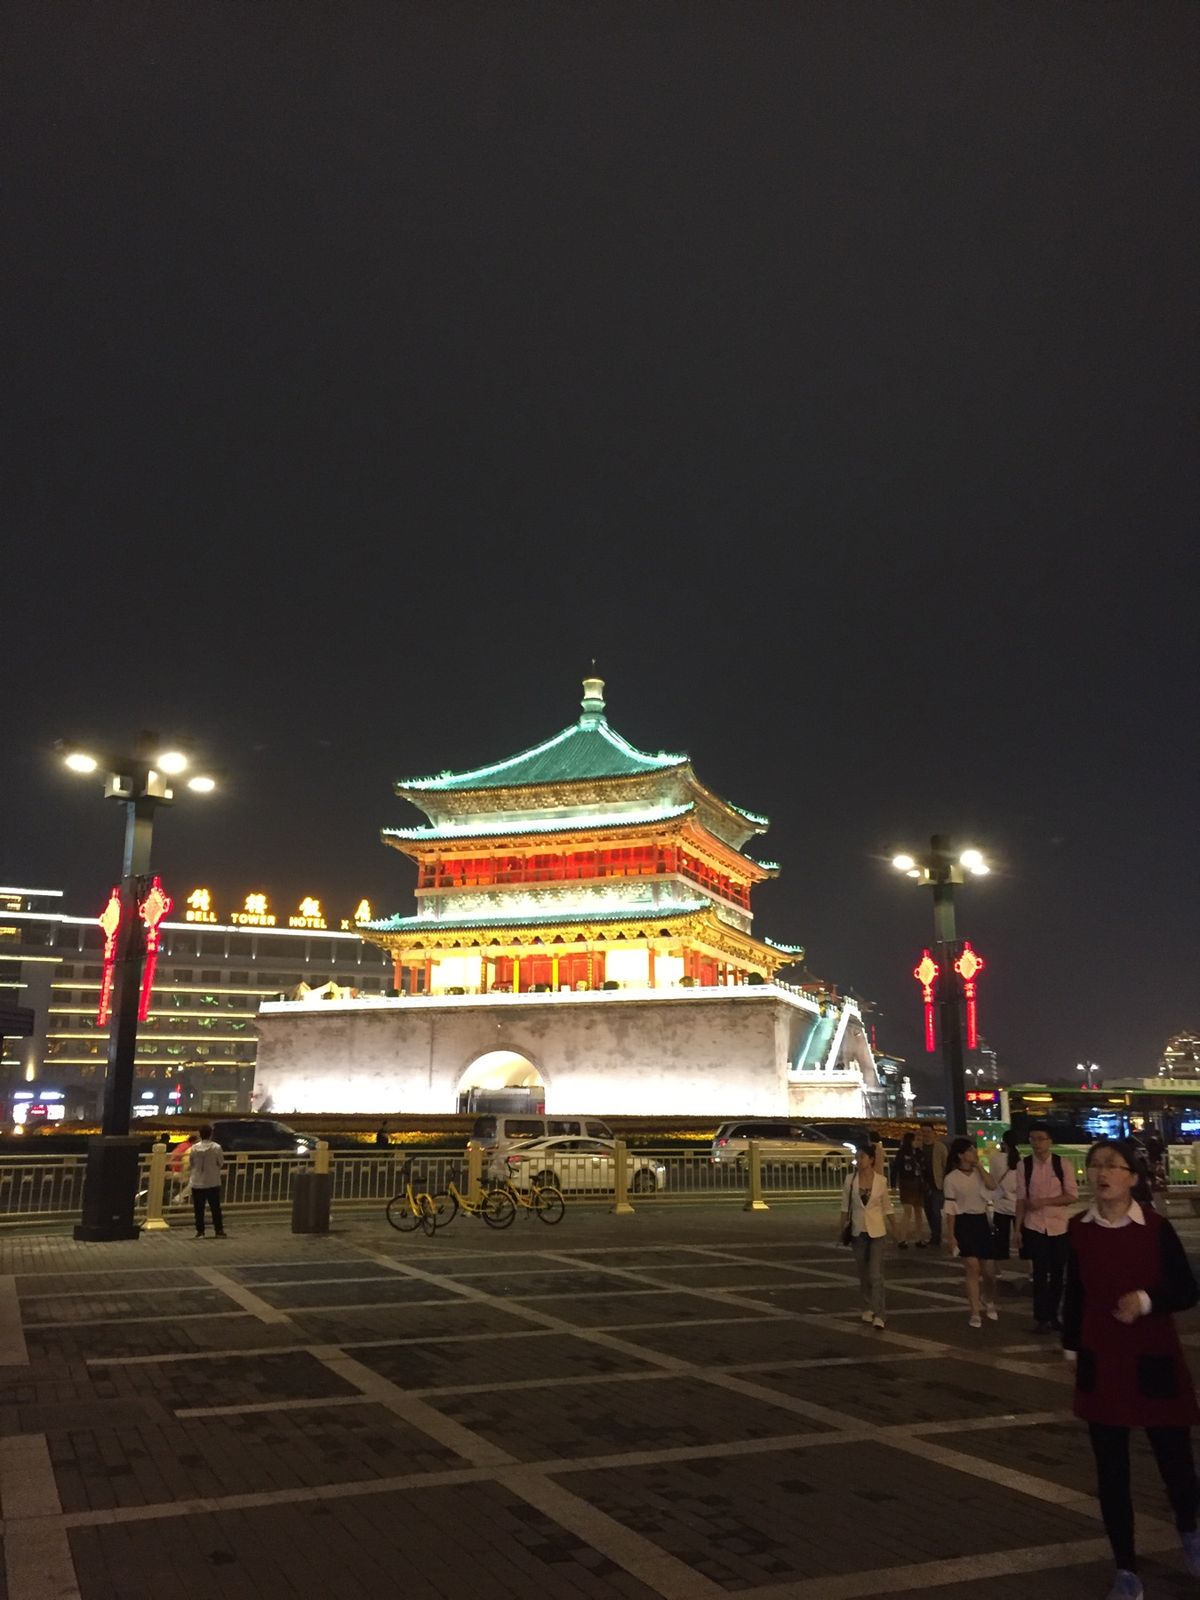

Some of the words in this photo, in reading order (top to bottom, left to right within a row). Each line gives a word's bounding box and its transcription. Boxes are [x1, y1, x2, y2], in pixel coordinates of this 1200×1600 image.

[186, 910, 217, 922] BELL
[231, 912, 276, 926] TOWER
[289, 916, 328, 929] HOTEL
